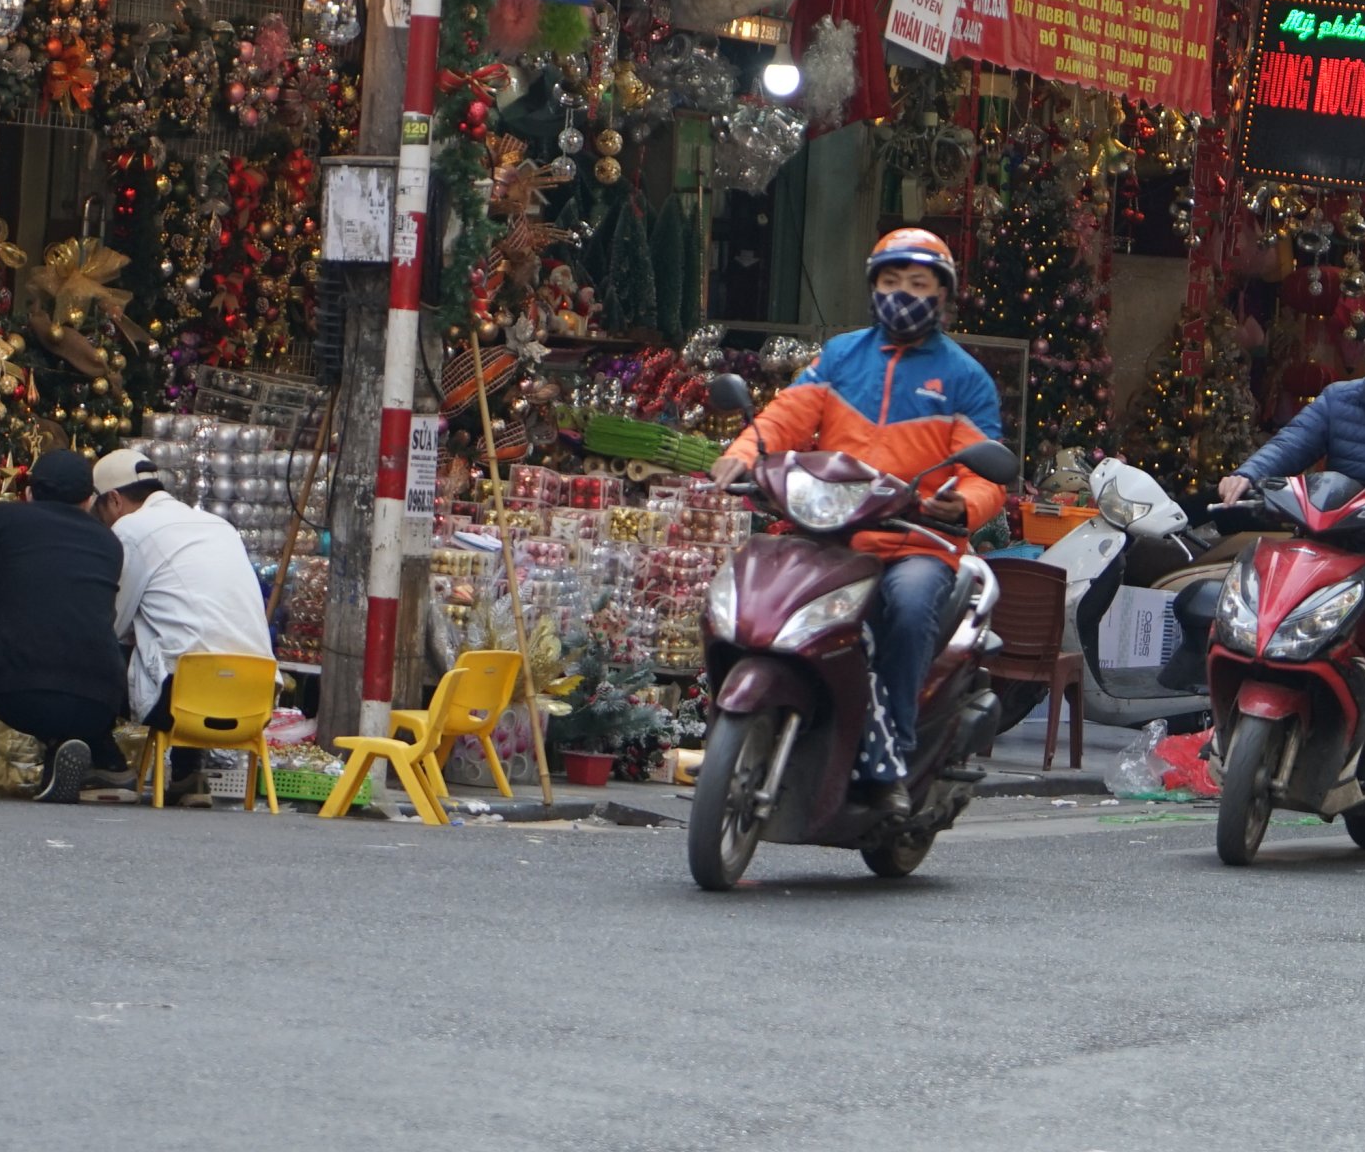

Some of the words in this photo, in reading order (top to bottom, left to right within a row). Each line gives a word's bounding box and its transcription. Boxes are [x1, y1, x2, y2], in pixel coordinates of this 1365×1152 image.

[891, 11, 923, 44] NHÂN
[922, 22, 947, 56] VIÊN
[1081, 14, 1102, 35] CÁC
[1104, 20, 1126, 44] LOẠI
[1279, 8, 1316, 41] Mỹ
[1062, 33, 1097, 58] TRANG
[1137, 73, 1158, 94] TẾT
[1256, 40, 1314, 111] HÙNG
[404, 122, 429, 135] 420
[412, 420, 432, 451] SỬA
